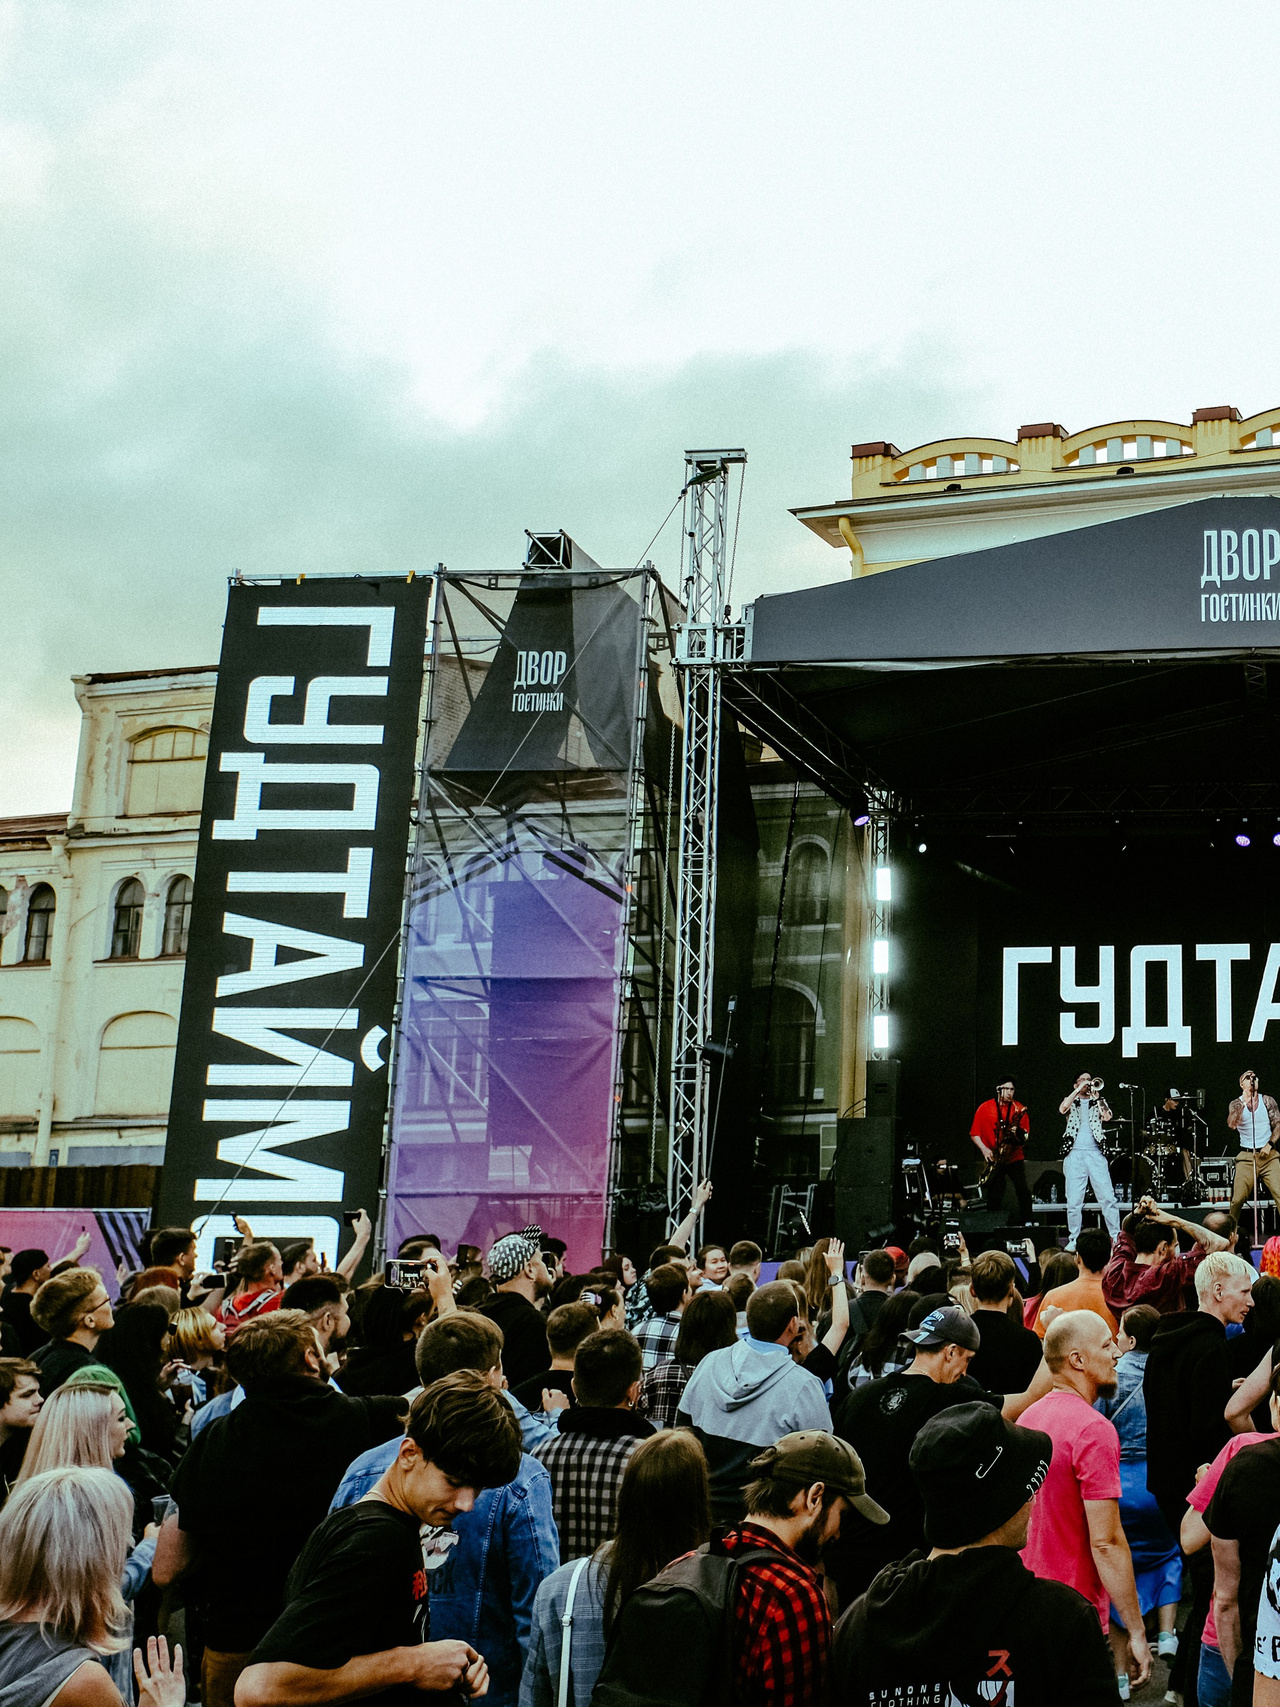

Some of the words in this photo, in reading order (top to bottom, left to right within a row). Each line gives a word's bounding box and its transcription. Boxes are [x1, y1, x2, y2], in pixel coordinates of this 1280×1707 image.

[1201, 529, 1280, 589] ДВОР
[513, 650, 567, 690] ДВОР
[511, 692, 564, 712] ГОСТИНКИ
[868, 1682, 941, 1701] SUNONE
